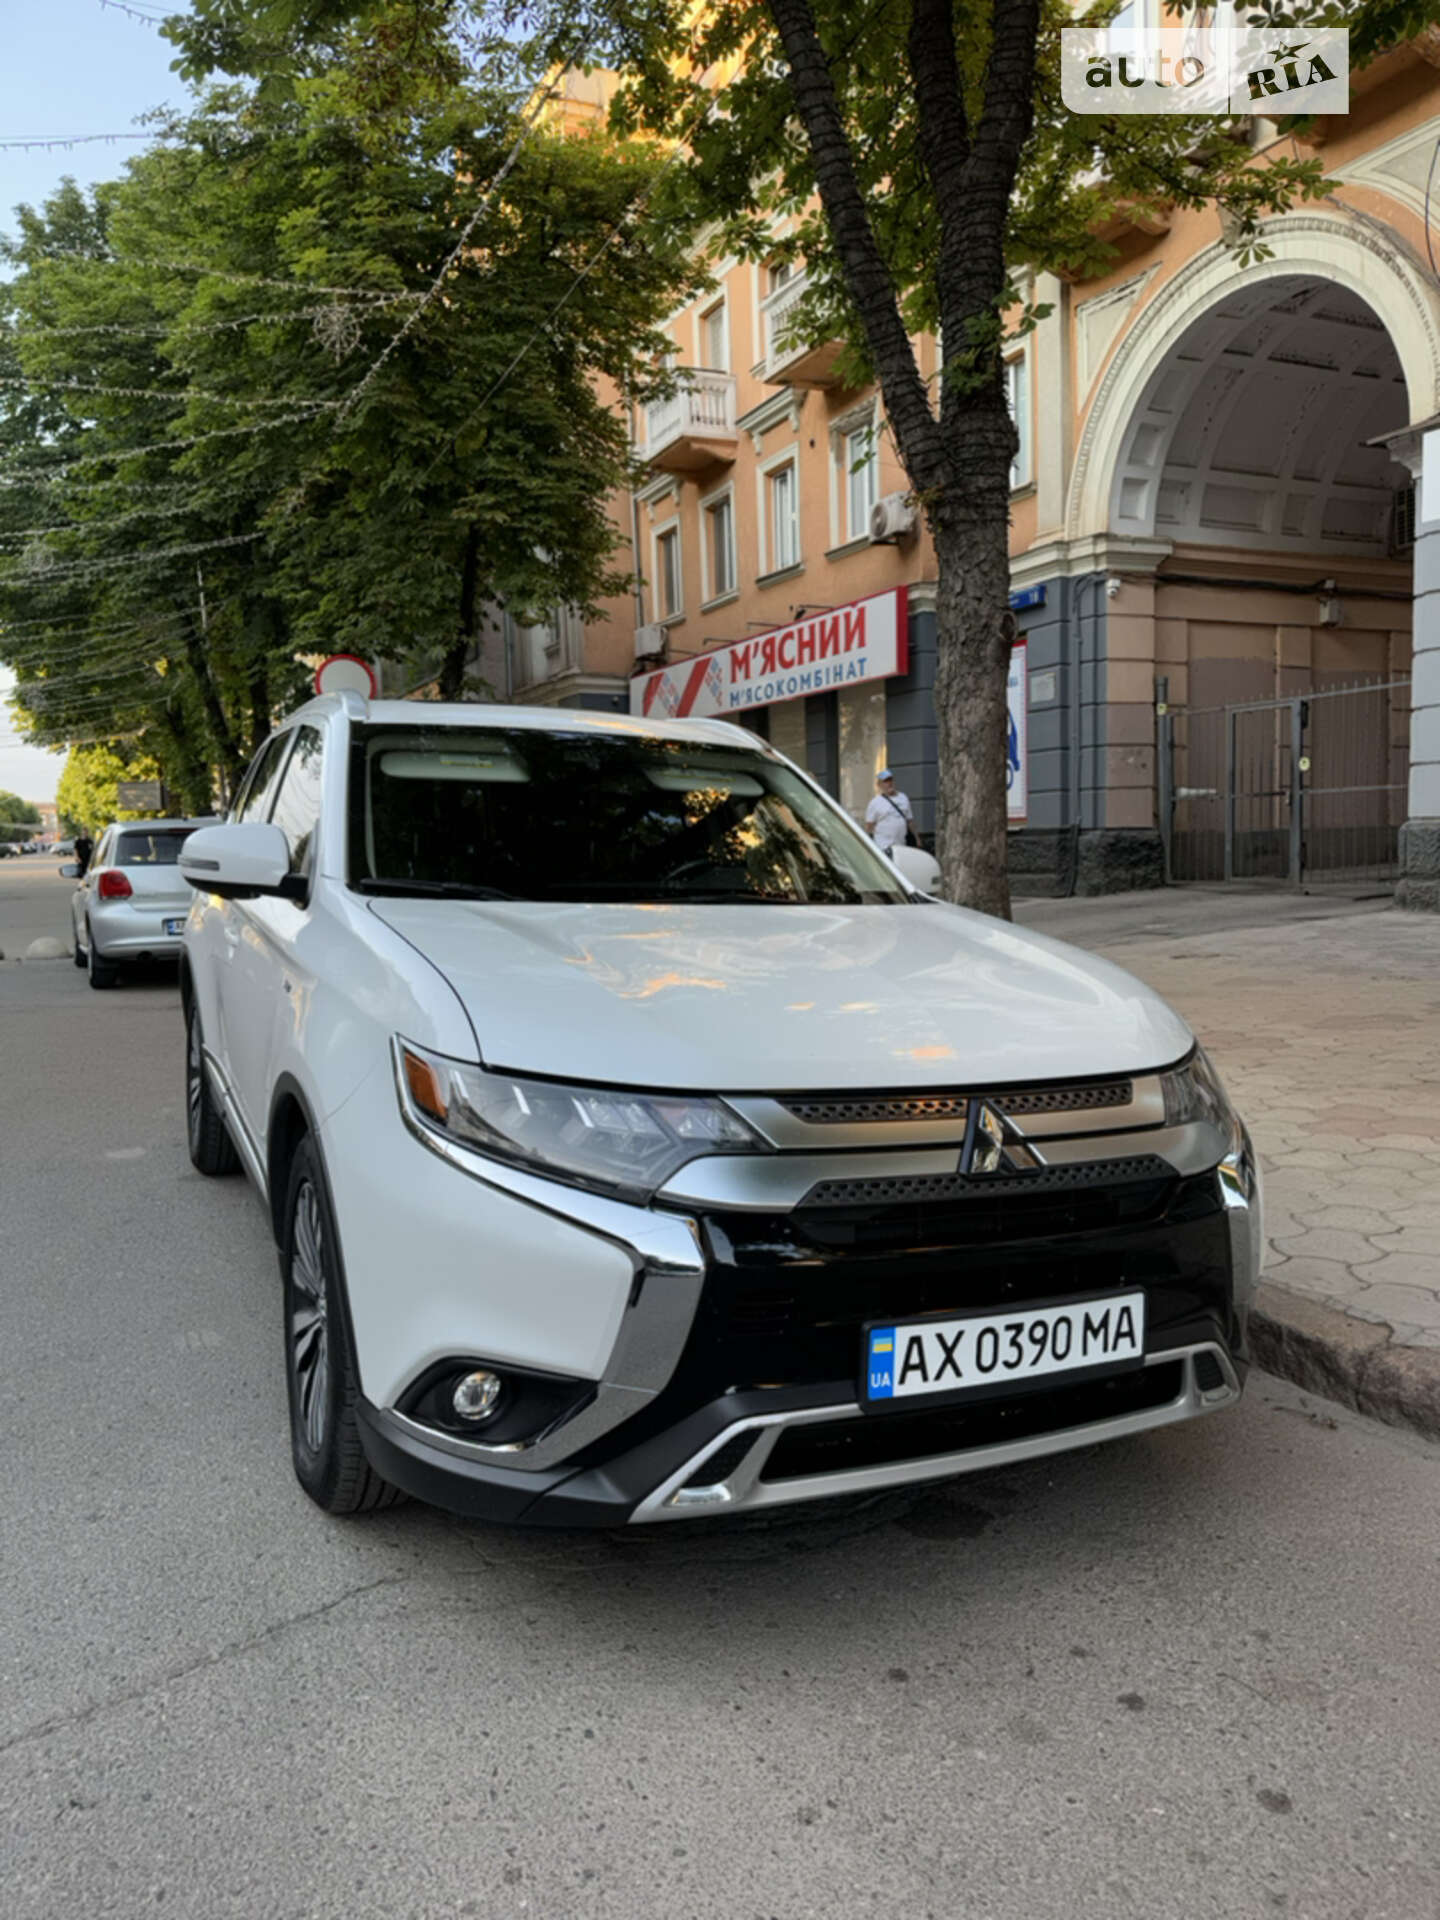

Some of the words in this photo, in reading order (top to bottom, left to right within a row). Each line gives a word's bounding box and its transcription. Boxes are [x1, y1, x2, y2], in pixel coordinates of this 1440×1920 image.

[729, 657, 867, 707] М'ЯСОКОМБІНАТ
[898, 1330, 965, 1385] AX
[975, 1316, 1073, 1374] 0390
[1082, 1306, 1137, 1356] MA
[870, 1372, 891, 1388] UA
